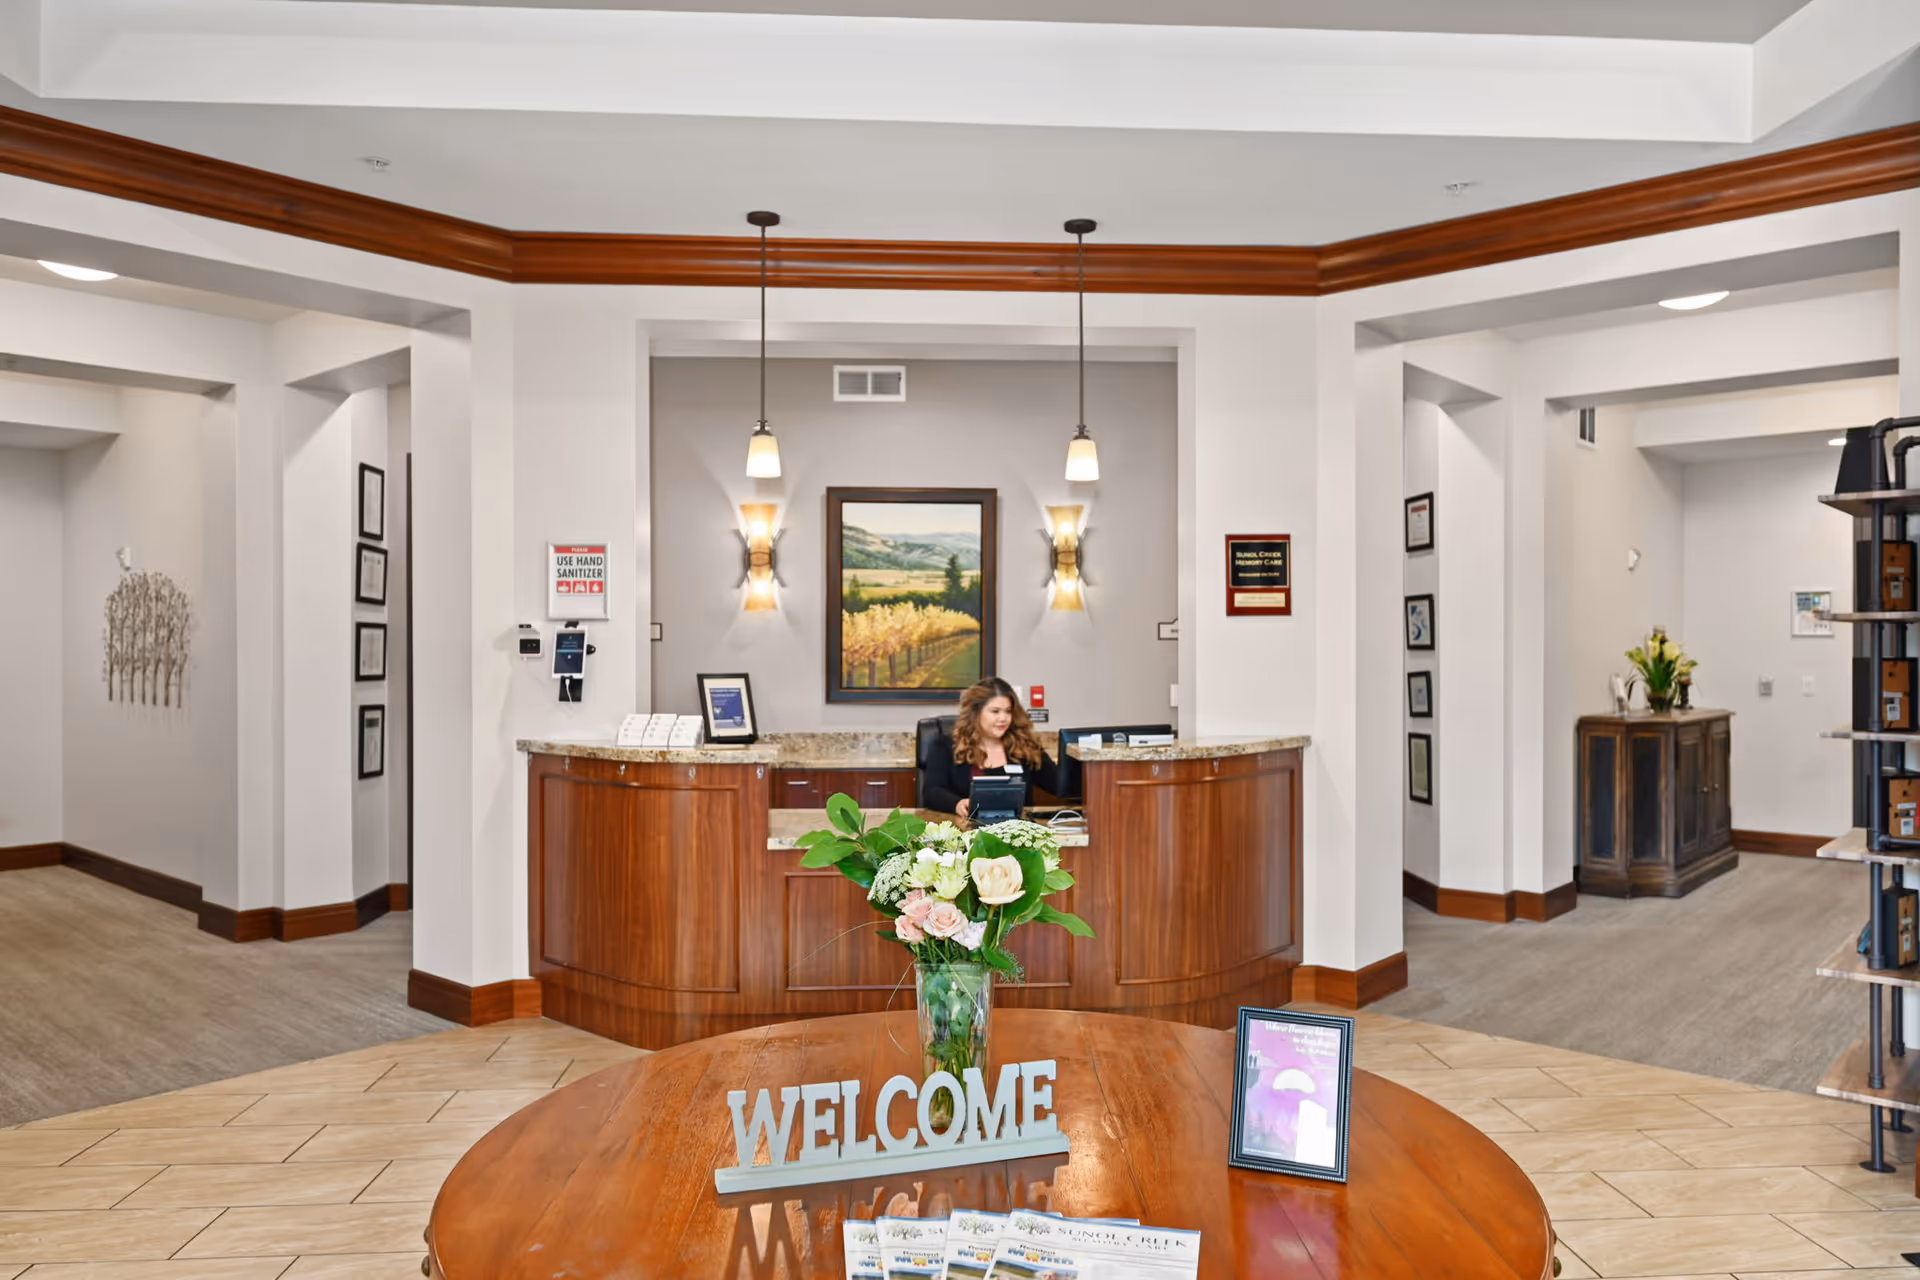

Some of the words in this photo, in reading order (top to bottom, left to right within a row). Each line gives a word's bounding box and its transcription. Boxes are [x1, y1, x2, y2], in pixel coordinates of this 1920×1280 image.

[557, 556, 573, 566] USE
[577, 556, 603, 566] HAND
[557, 569, 603, 578] SANITIZER
[727, 1059, 1057, 1169] WELCOME
[1058, 1227, 1116, 1241] SUNOL
[1126, 1235, 1188, 1249] CREEK
